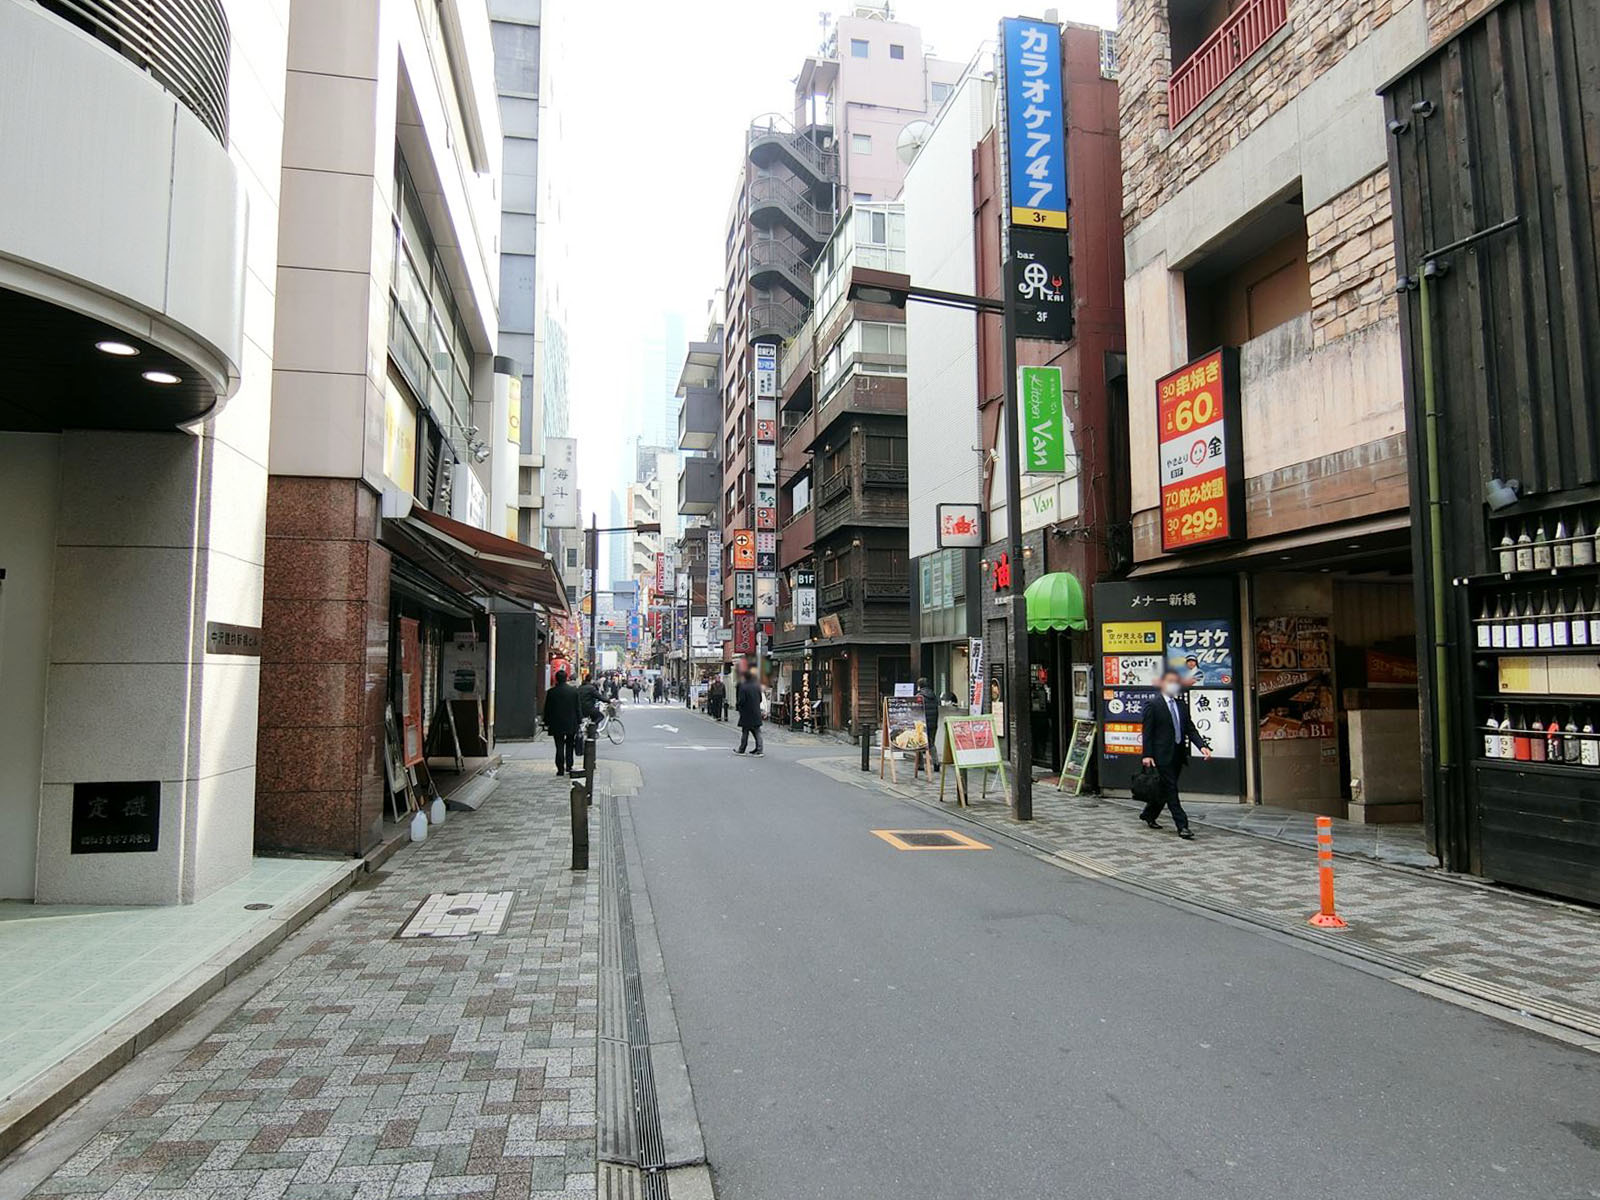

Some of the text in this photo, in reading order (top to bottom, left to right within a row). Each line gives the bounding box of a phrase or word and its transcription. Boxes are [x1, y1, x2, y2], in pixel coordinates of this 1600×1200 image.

[1020, 27, 1053, 207] カラオケ747
[1033, 211, 1047, 223] 3F
[1016, 249, 1035, 260] bar
[1036, 310, 1048, 322] 3F
[1162, 383, 1175, 399] 30
[1175, 391, 1213, 432] 60
[1032, 419, 1054, 466] Van
[1033, 493, 1054, 514] Van
[1181, 507, 1218, 536] 299
[798, 574, 815, 585] B1F
[1169, 629, 1229, 648] カラオケ
[1195, 648, 1230, 664] 747
